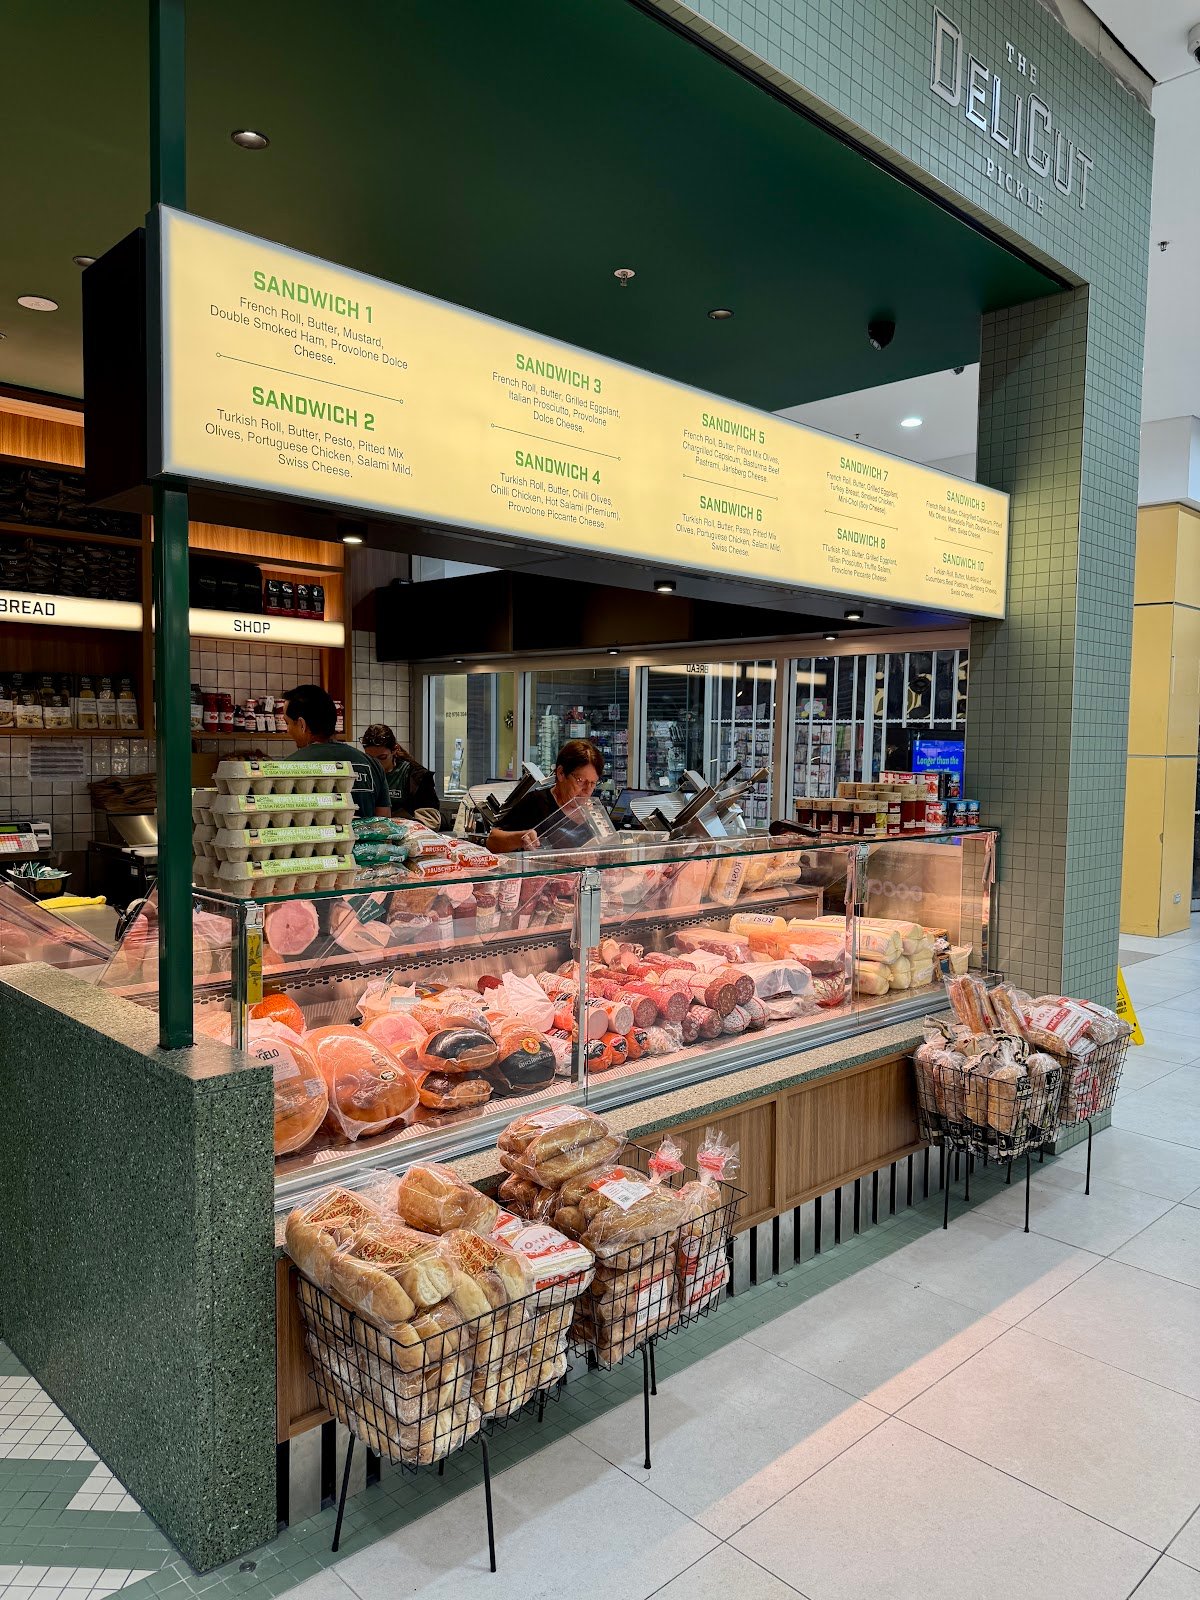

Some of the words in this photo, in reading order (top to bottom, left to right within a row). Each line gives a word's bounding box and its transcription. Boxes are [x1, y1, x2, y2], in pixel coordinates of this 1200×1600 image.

[1005, 41, 1037, 85] THE
[930, 4, 1094, 210] DELICUT
[985, 157, 1045, 217] PICKLE
[253, 270, 359, 320] SANDWICH
[365, 306, 372, 324] 1
[210, 304, 250, 326] Double
[253, 316, 297, 339] Smoked
[300, 329, 328, 349] Ham,
[330, 338, 379, 362] Provolone
[382, 353, 408, 370] Dolce
[240, 296, 278, 318] French
[281, 308, 304, 327] Roll,
[307, 316, 340, 337] Butter,
[343, 326, 384, 350] Mustard,
[293, 344, 336, 365] Cheese.
[516, 353, 590, 391] SANDWICH
[593, 378, 601, 394] 3
[492, 371, 520, 388] French
[565, 393, 588, 408] Grilled
[252, 386, 358, 428] SANDWICH
[364, 412, 375, 432] 2
[508, 390, 532, 405] Italian
[572, 408, 607, 427] Provolone
[533, 410, 554, 425] Dolce
[216, 408, 257, 427] Turkish
[261, 418, 284, 435] Roll,
[288, 424, 321, 443] Butter,
[324, 432, 355, 450] Pesto,
[358, 439, 385, 455] Pitted
[388, 446, 404, 459] Mix
[701, 412, 756, 442] SANDWICH
[758, 430, 765, 444] 5
[205, 422, 244, 442] Olives,
[247, 431, 308, 454] Portuguese
[311, 444, 354, 465] Chicken,
[357, 454, 390, 470] Salami
[392, 462, 413, 477] Mild,
[278, 453, 309, 470] Swiss
[311, 460, 353, 478] Cheese.
[515, 450, 588, 482] SANDWICH
[591, 470, 601, 485] 4
[839, 456, 882, 480] SANDWICH
[883, 470, 889, 482] 7
[490, 483, 509, 496] Chilli
[545, 495, 558, 507] Hot
[559, 498, 584, 512] Salami
[499, 471, 528, 487] Turkish
[572, 488, 588, 500] Chilli
[508, 500, 546, 517] Provolone
[547, 508, 577, 523] Piccante
[699, 495, 754, 520] SANDWICH
[756, 508, 763, 522] 6
[946, 490, 980, 510] SANDWICH
[980, 501, 986, 512] 9
[837, 527, 879, 548] SANDWICH
[880, 538, 886, 550] 8
[942, 552, 976, 570] SANDWICH
[977, 560, 984, 572] 10
[0, 598, 55, 616] BREAD
[233, 619, 271, 634] SHOP
[917, 755, 936, 767] Longer
[937, 755, 950, 765] than
[950, 756, 959, 765] the
